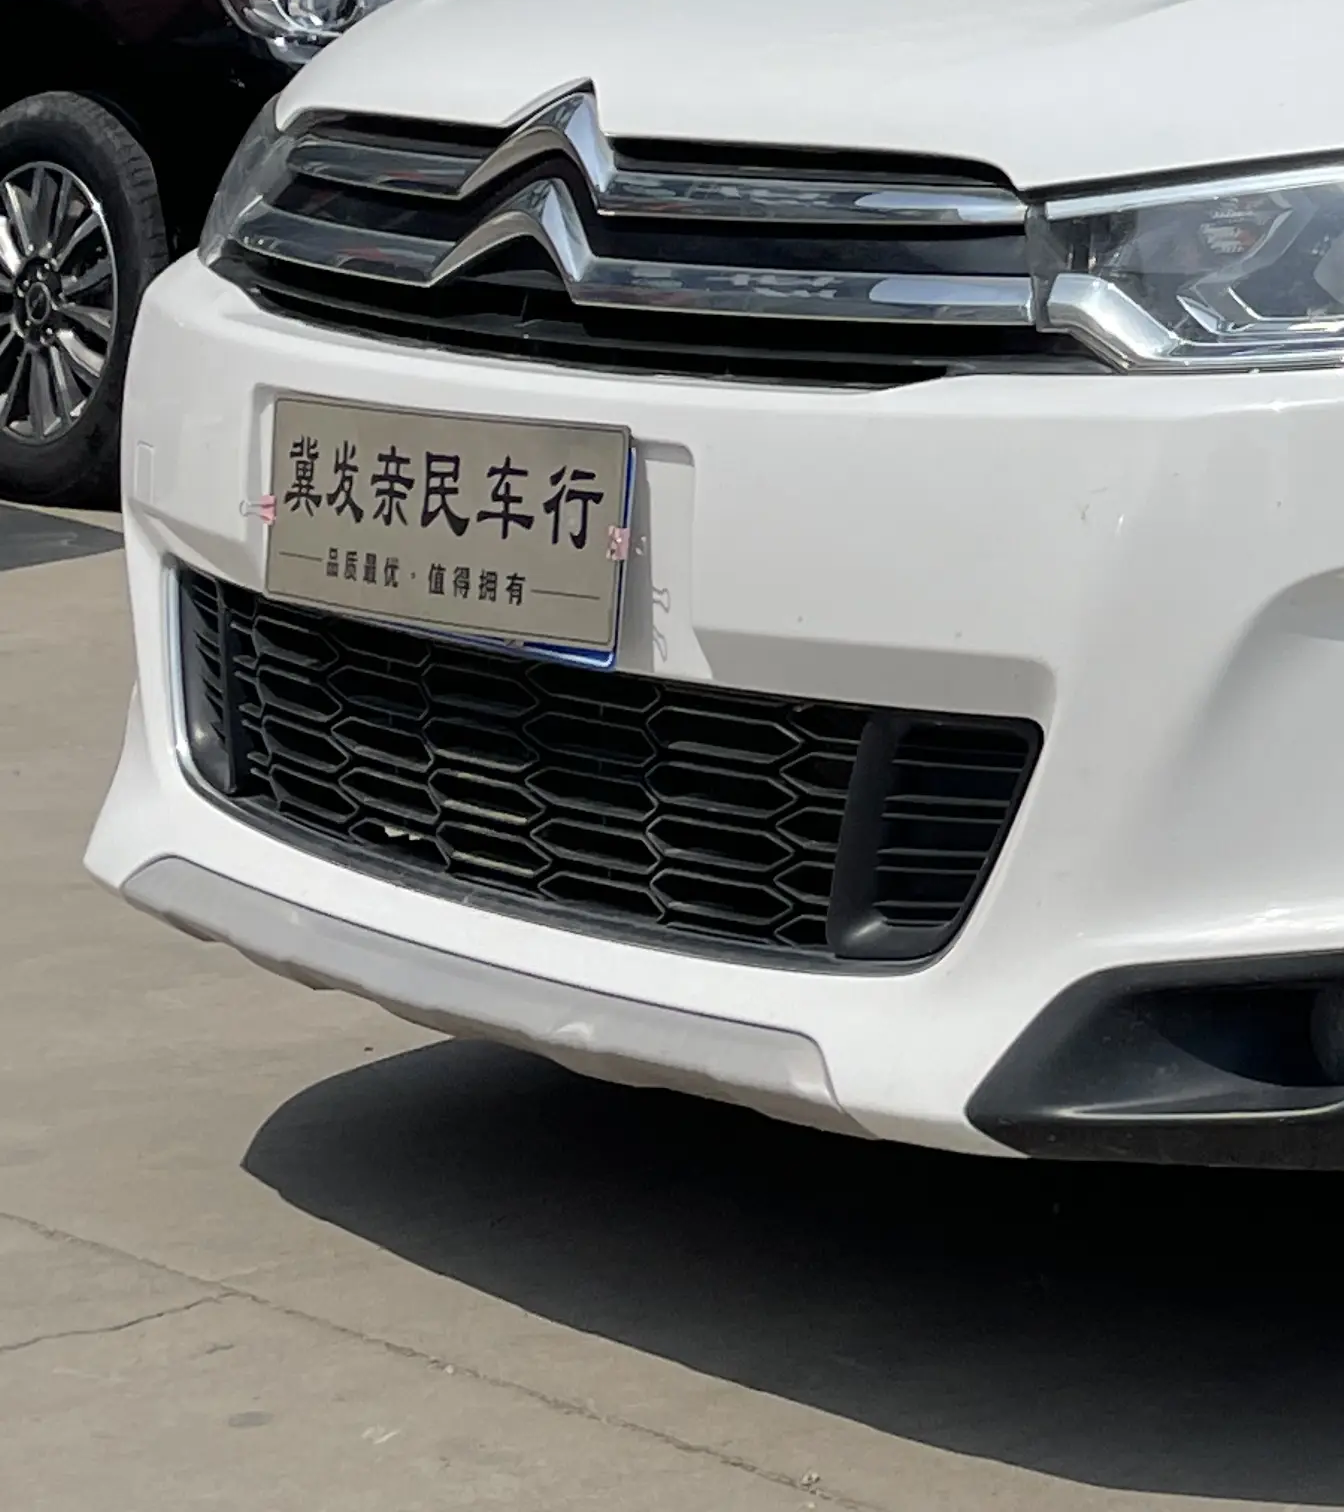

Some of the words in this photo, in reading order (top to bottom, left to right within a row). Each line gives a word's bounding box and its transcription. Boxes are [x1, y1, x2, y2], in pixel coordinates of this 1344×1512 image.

[283, 435, 605, 550] 冀发亲民车行
